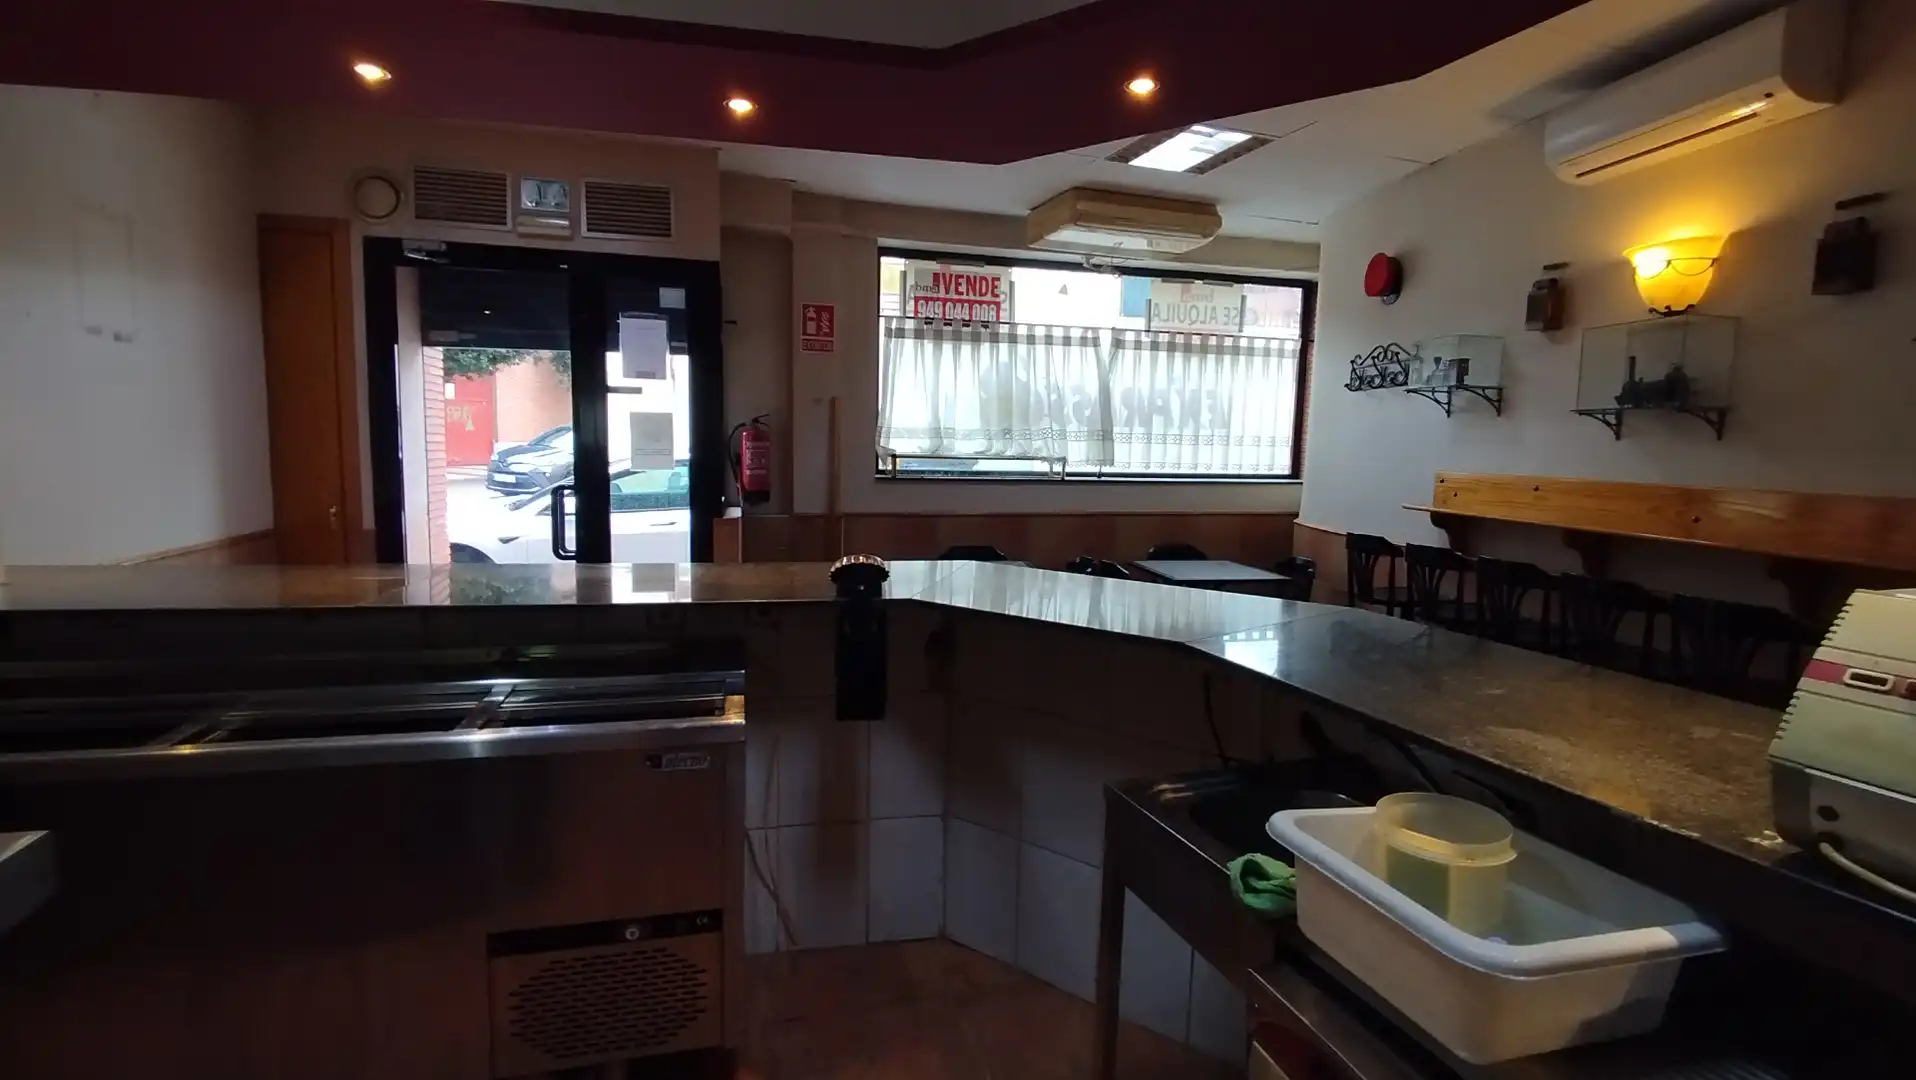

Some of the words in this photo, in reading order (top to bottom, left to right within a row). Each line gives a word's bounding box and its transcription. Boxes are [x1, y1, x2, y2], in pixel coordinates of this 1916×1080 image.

[941, 272, 1001, 298] VENDE
[917, 300, 943, 318] 949
[945, 302, 970, 320] 044
